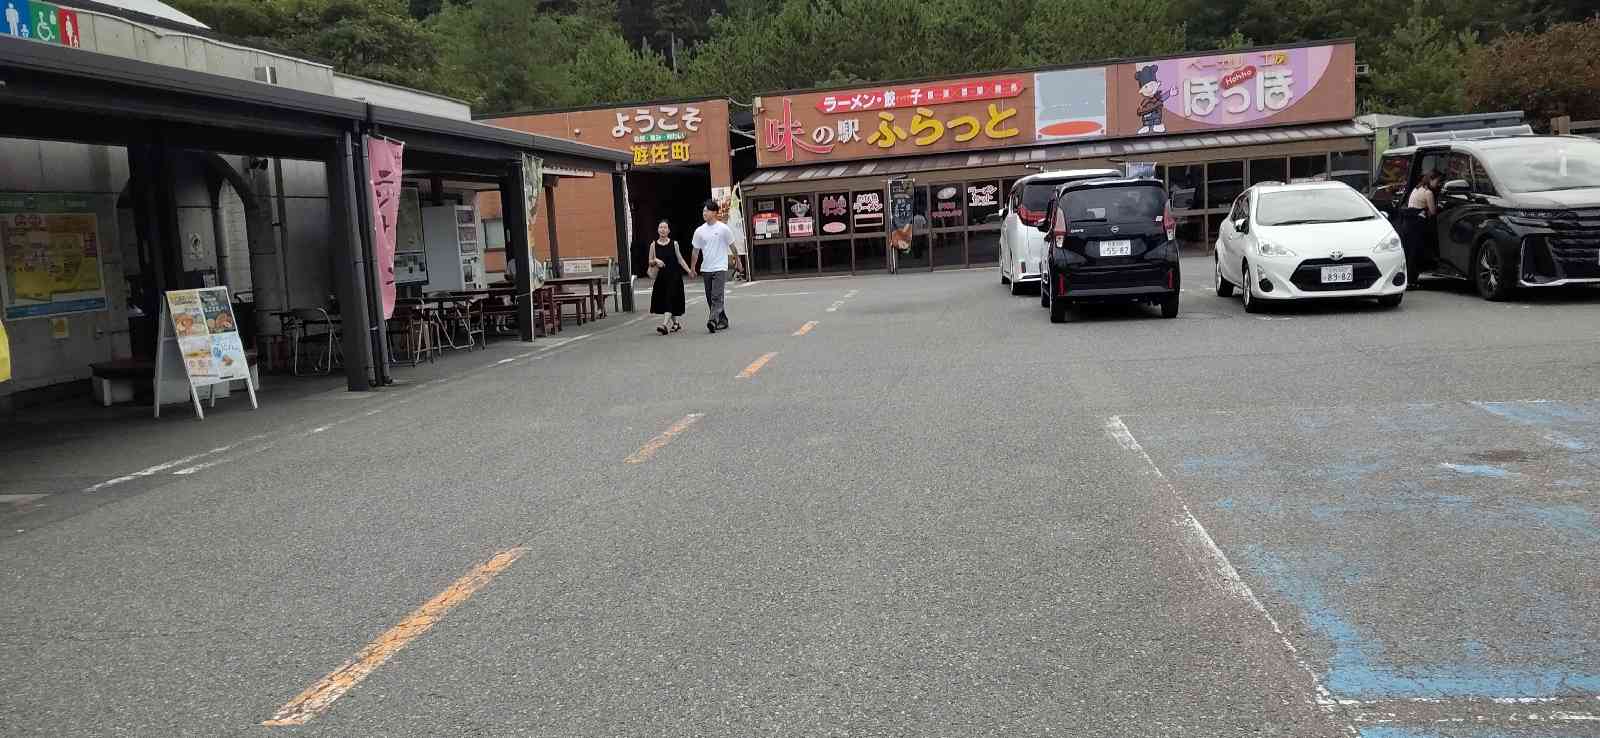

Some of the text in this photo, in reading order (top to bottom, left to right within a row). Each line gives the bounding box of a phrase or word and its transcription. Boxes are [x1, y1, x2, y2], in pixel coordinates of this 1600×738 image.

[611, 107, 704, 138] ようこそ
[765, 97, 1020, 162] 味の駅 ふらっと
[630, 142, 690, 165] 遊佐町
